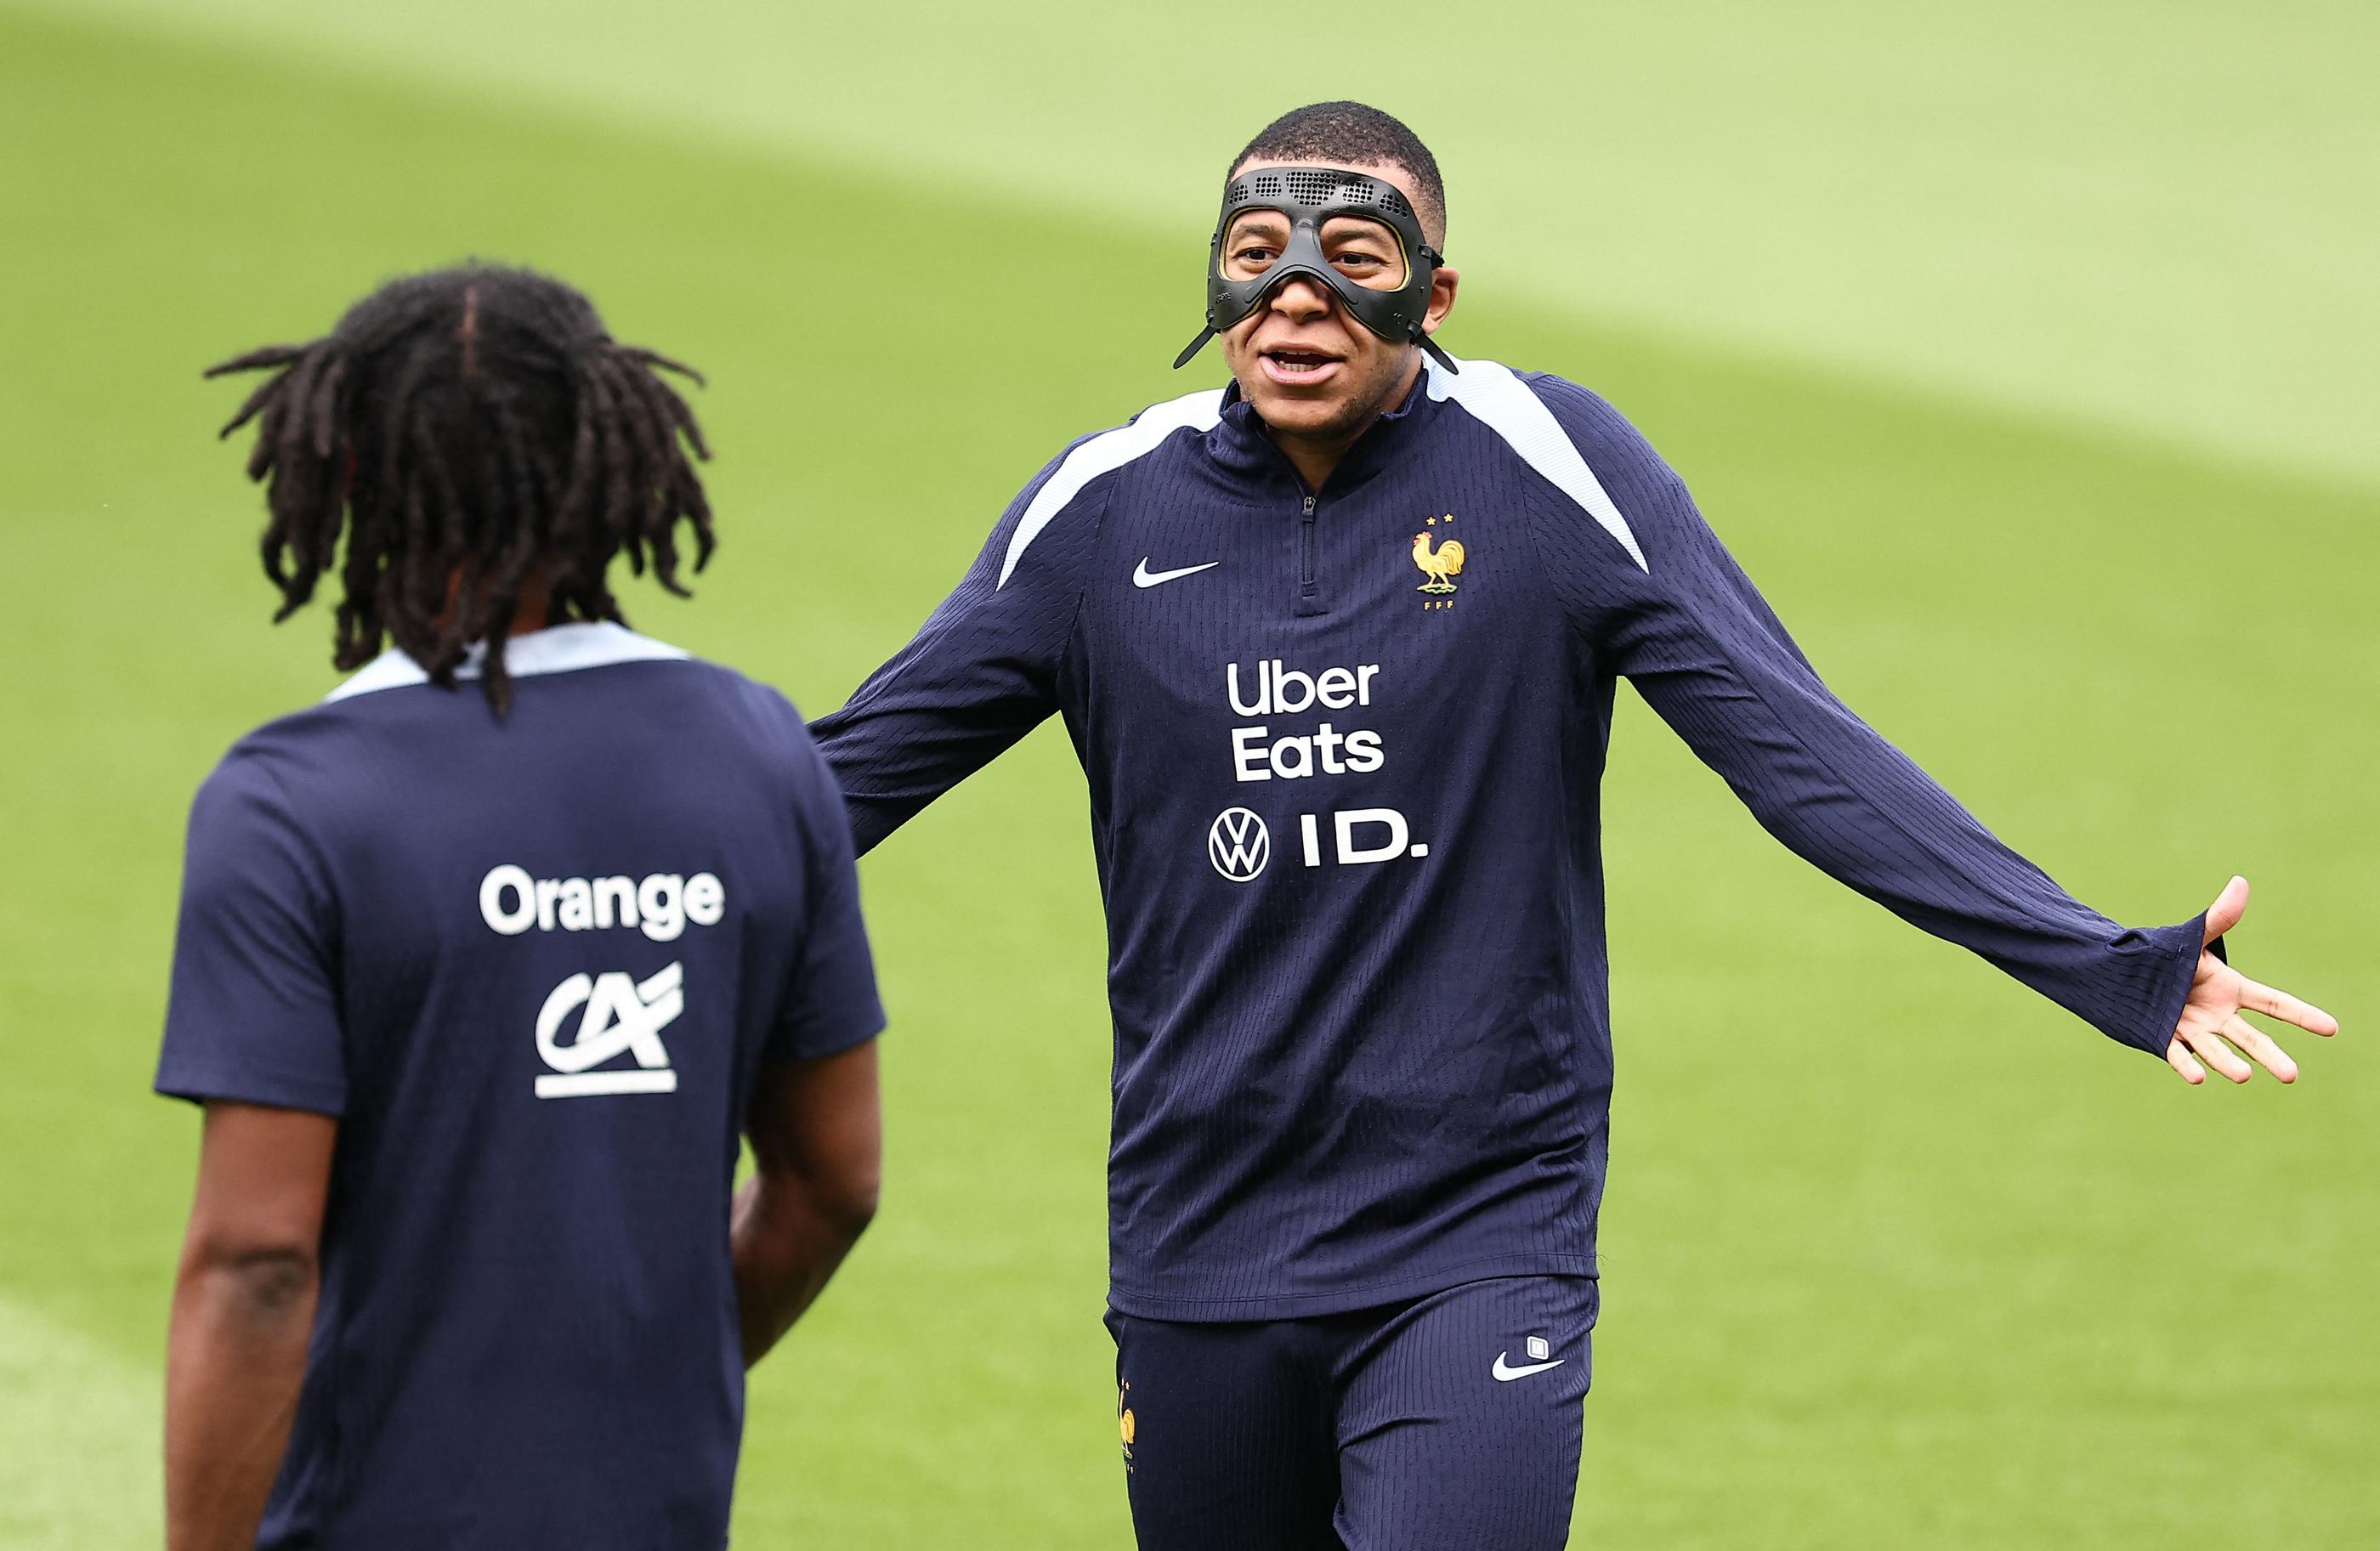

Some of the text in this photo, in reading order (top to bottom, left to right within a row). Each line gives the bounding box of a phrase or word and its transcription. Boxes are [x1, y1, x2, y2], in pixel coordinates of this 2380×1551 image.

[1227, 659, 1380, 716] Uber
[1232, 723, 1385, 782] Eats
[1209, 807, 1429, 882] VW ID.
[479, 864, 724, 942] Orange
